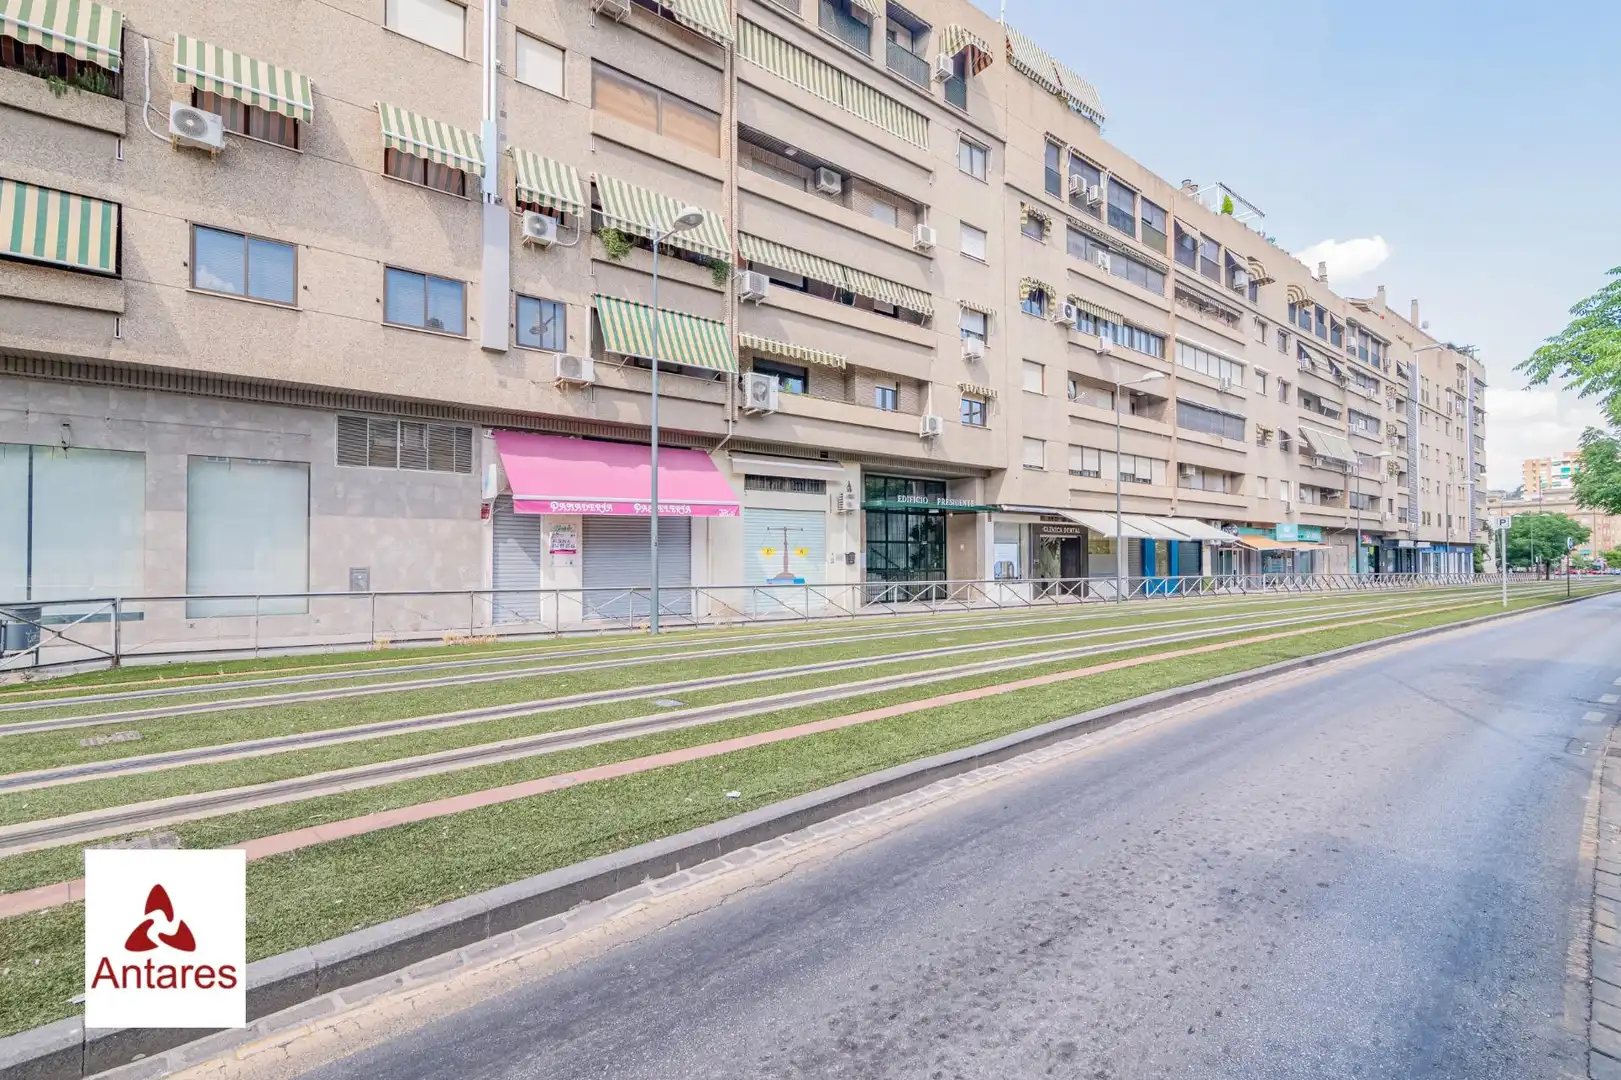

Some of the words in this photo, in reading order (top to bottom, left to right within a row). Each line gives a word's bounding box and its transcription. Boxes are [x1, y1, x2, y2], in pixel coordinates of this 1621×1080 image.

[897, 495, 928, 505] EDIFICIO
[937, 497, 974, 508] PRESIDENTE
[634, 502, 692, 515] PASELERÍA
[1499, 518, 1507, 526] P
